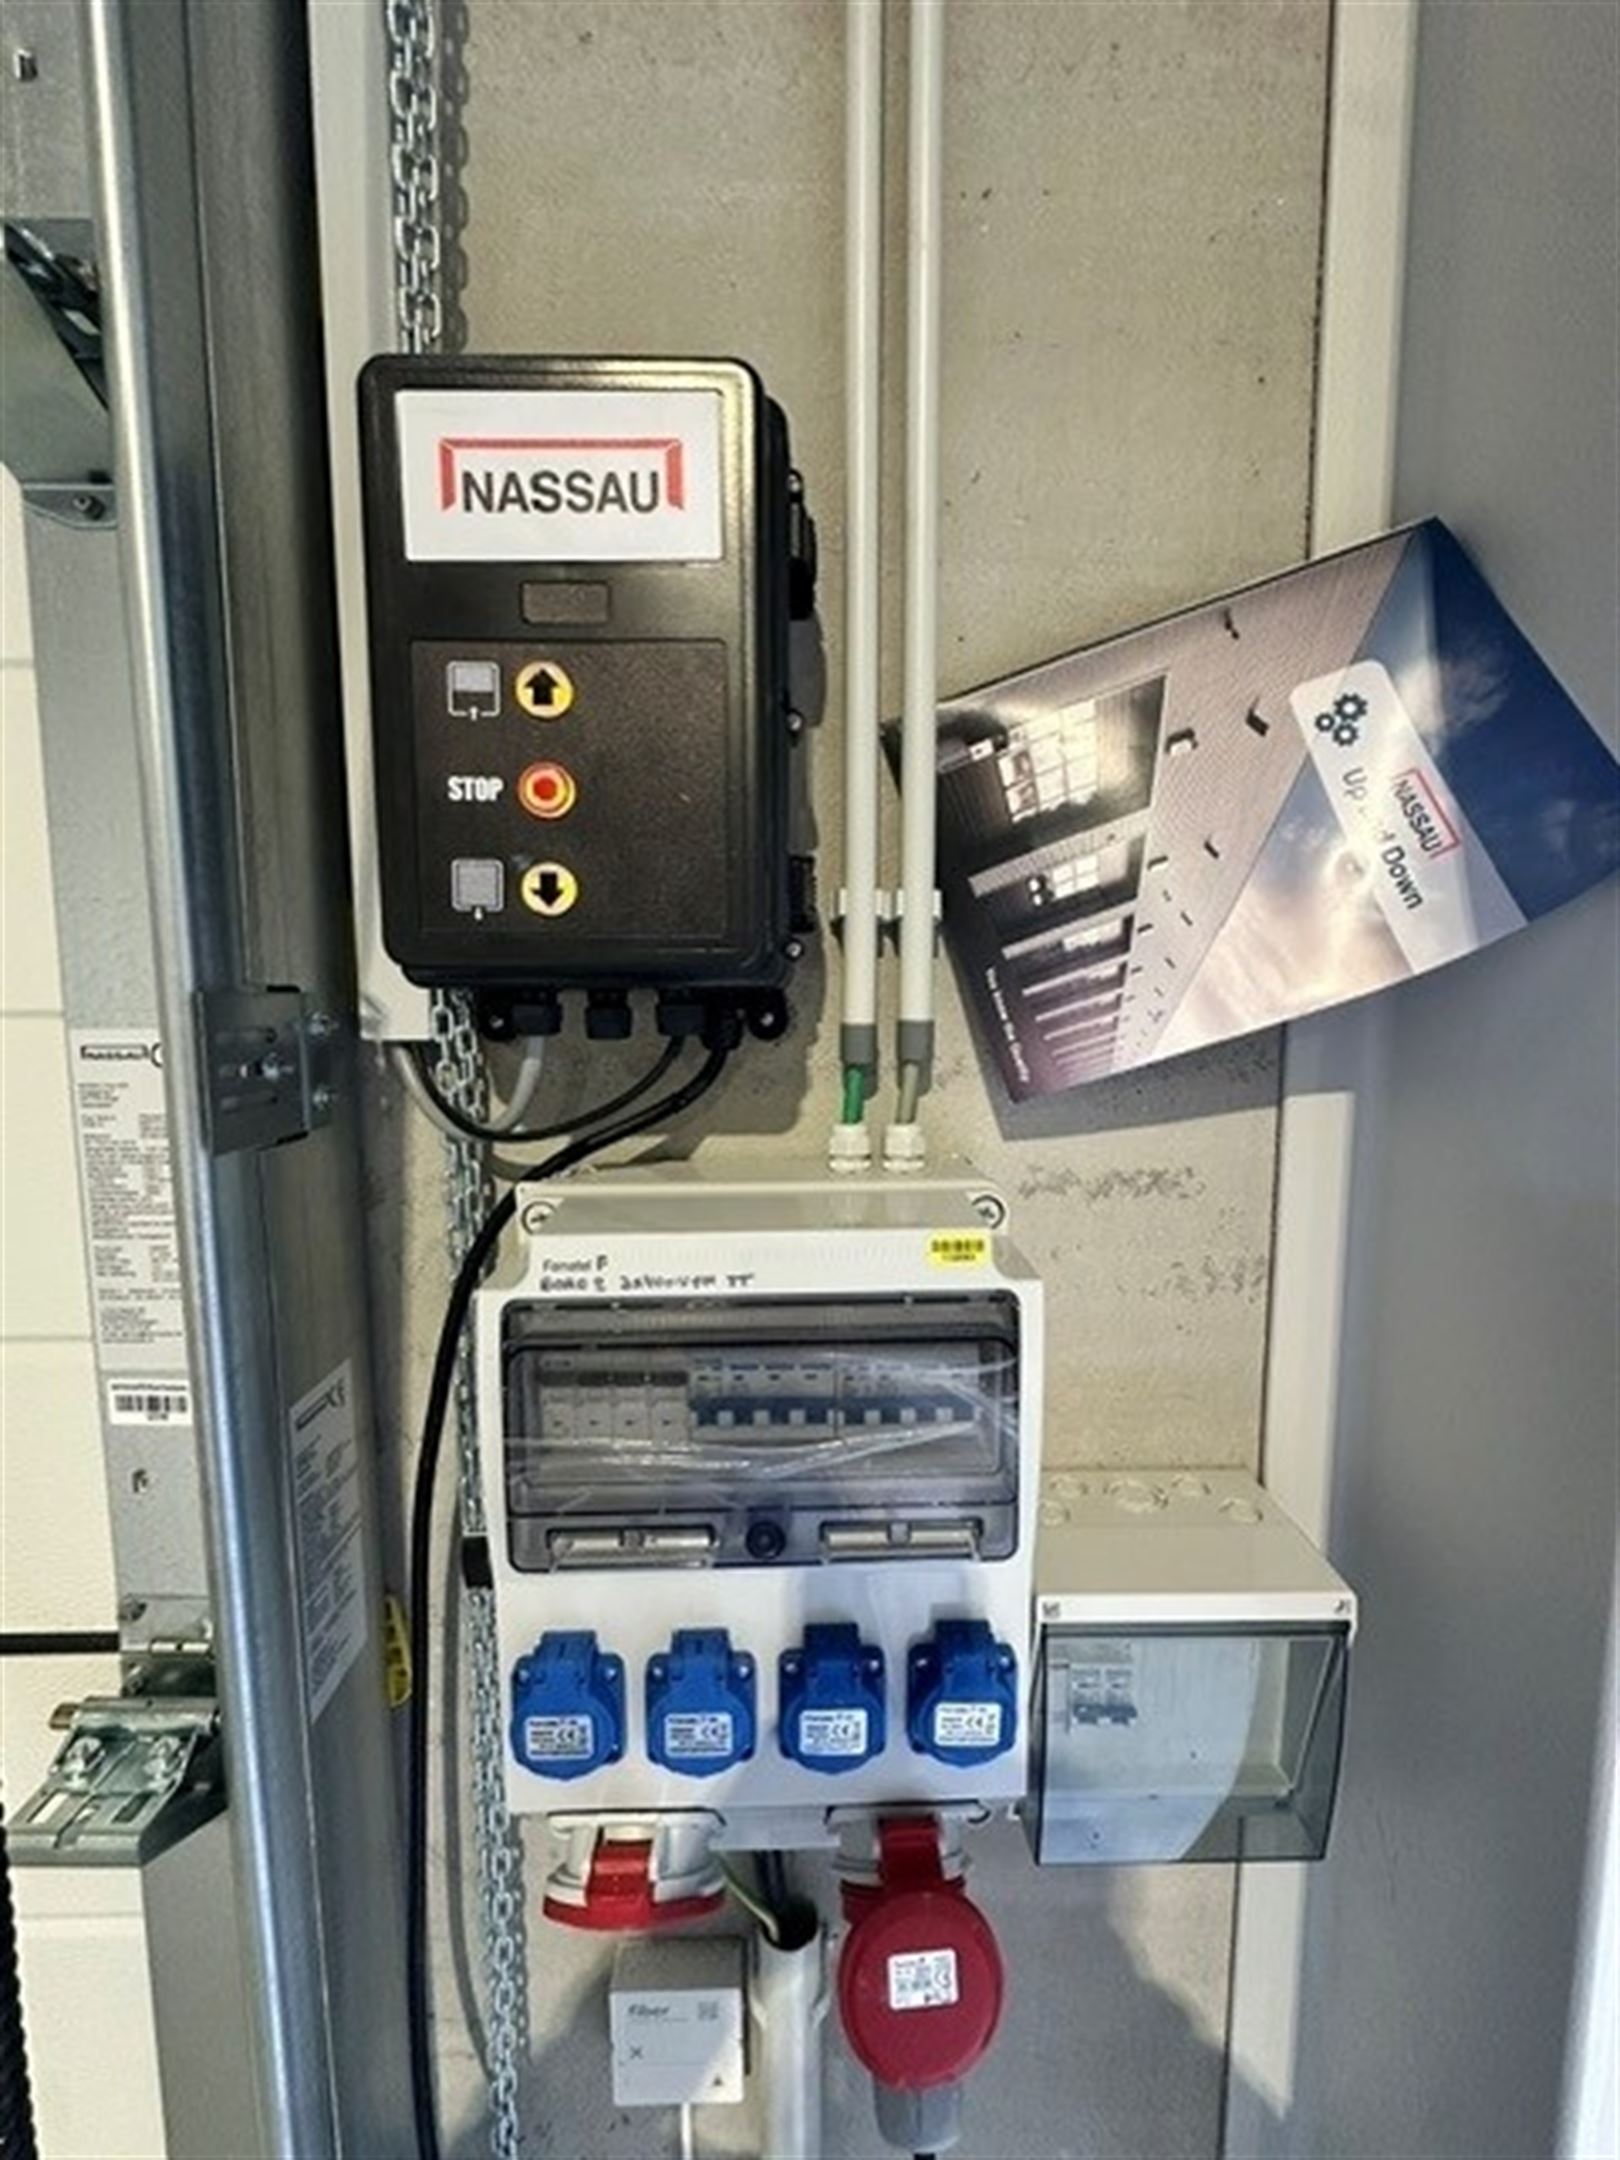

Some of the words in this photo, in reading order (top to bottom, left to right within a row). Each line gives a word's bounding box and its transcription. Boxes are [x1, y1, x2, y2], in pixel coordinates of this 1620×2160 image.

[461, 470, 660, 514] NASSAU
[447, 775, 504, 802] STOP
[1392, 779, 1443, 853] NASSAU
[1380, 844, 1424, 910] Down
